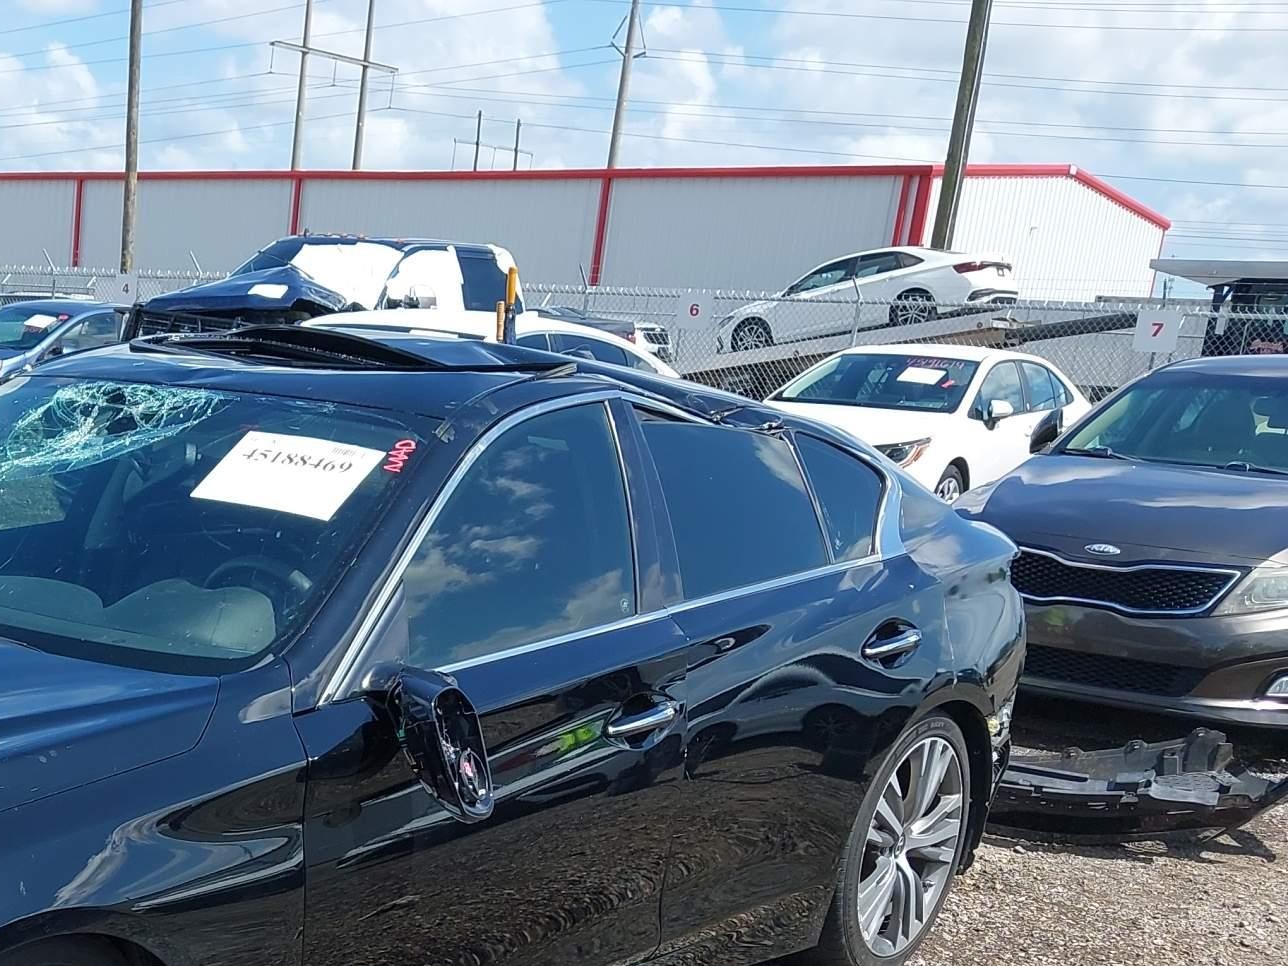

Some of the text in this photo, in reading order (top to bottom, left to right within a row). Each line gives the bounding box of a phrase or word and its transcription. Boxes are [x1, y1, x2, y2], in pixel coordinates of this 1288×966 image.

[122, 283, 129, 294] 4
[689, 303, 700, 317] 6
[1151, 322, 1165, 337] 7
[241, 447, 353, 474] 45188469
